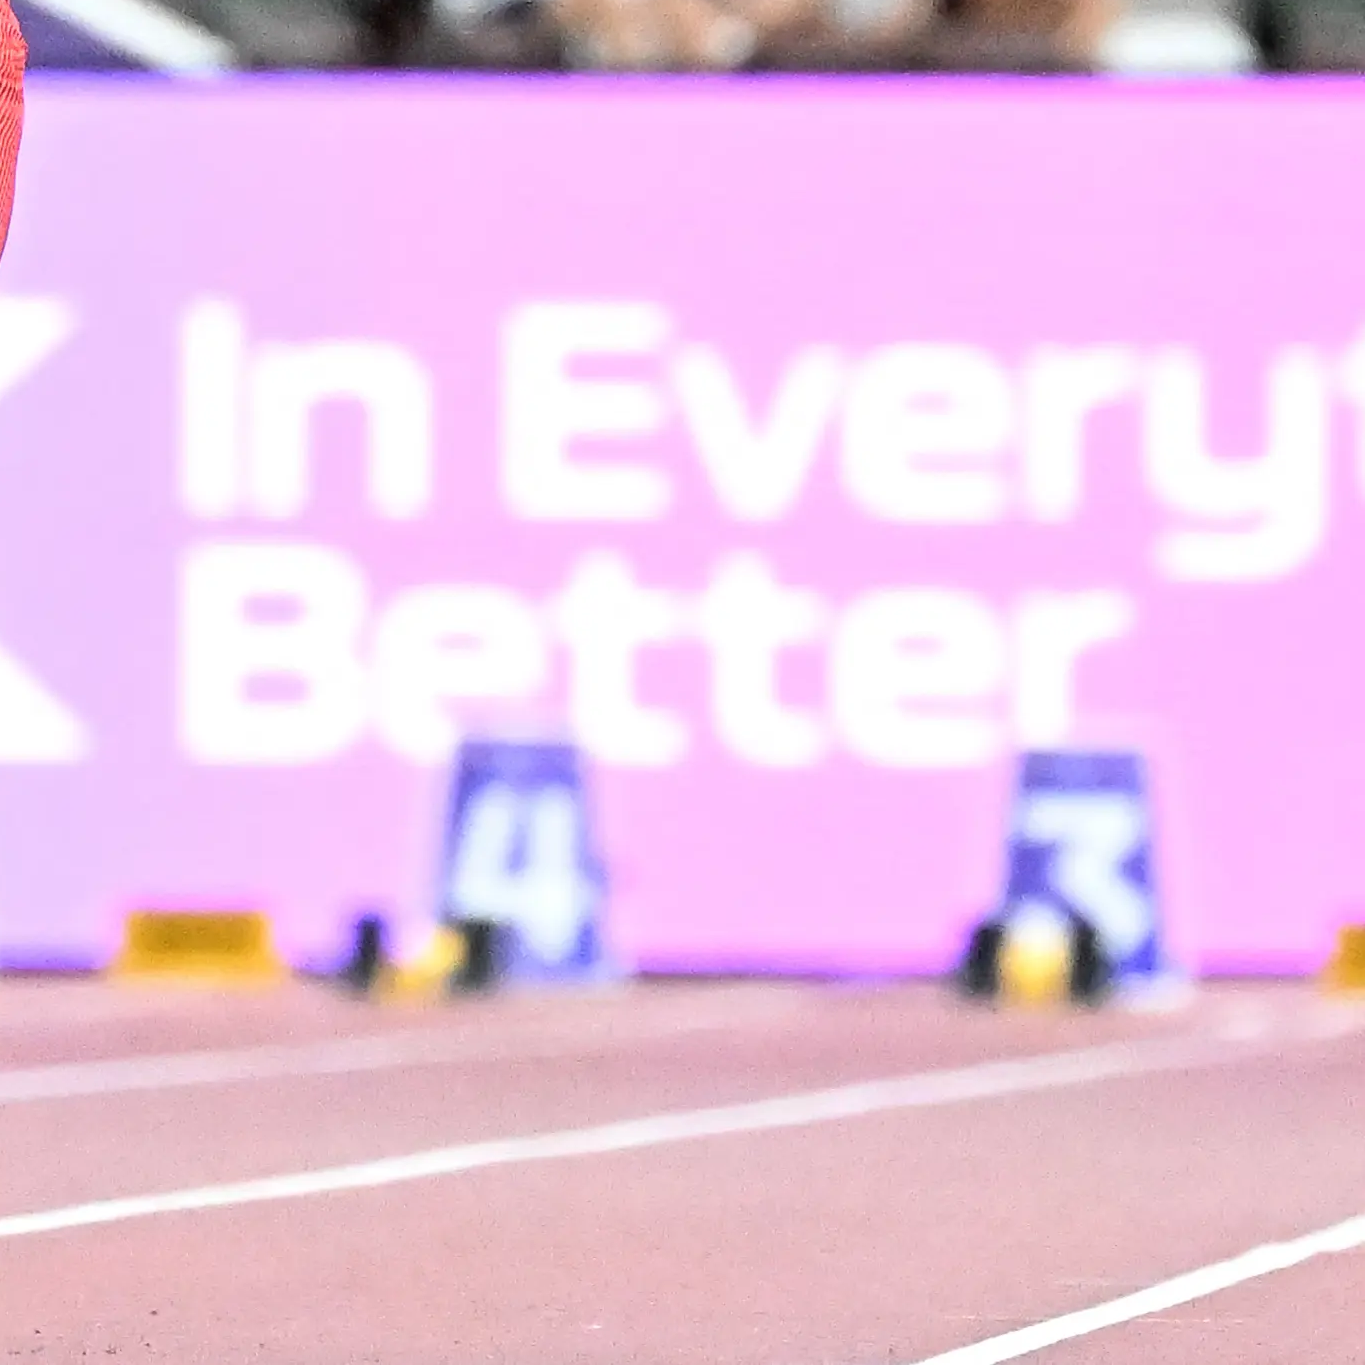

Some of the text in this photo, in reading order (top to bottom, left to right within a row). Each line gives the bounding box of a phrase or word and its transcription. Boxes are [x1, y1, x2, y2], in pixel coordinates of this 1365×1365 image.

[174, 293, 1365, 583] In Every
[176, 537, 1137, 768] Better
[452, 781, 598, 962] 4
